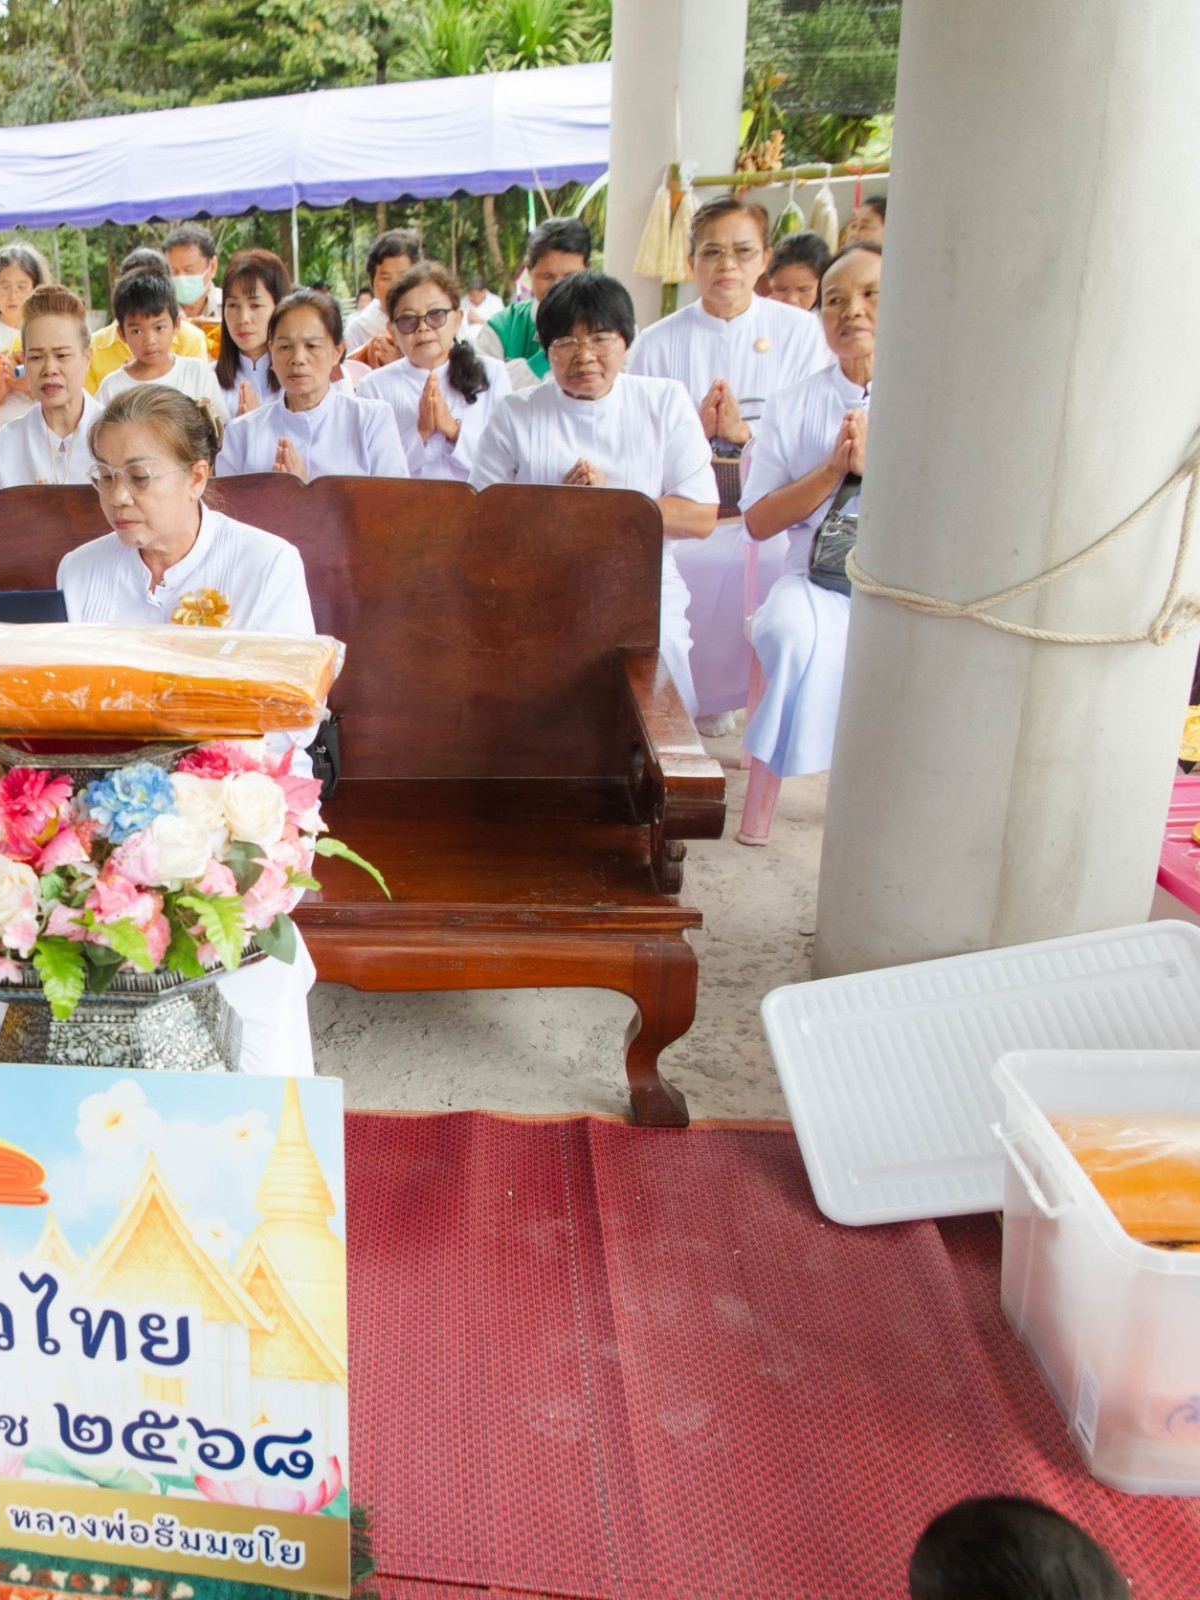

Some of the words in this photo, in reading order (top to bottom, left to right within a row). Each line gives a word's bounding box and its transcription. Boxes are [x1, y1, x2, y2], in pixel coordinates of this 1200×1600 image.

[53, 1402, 315, 1480] ๒๕๖๘
[9, 1508, 302, 1565] หลวงพ่อธัมมชโย
